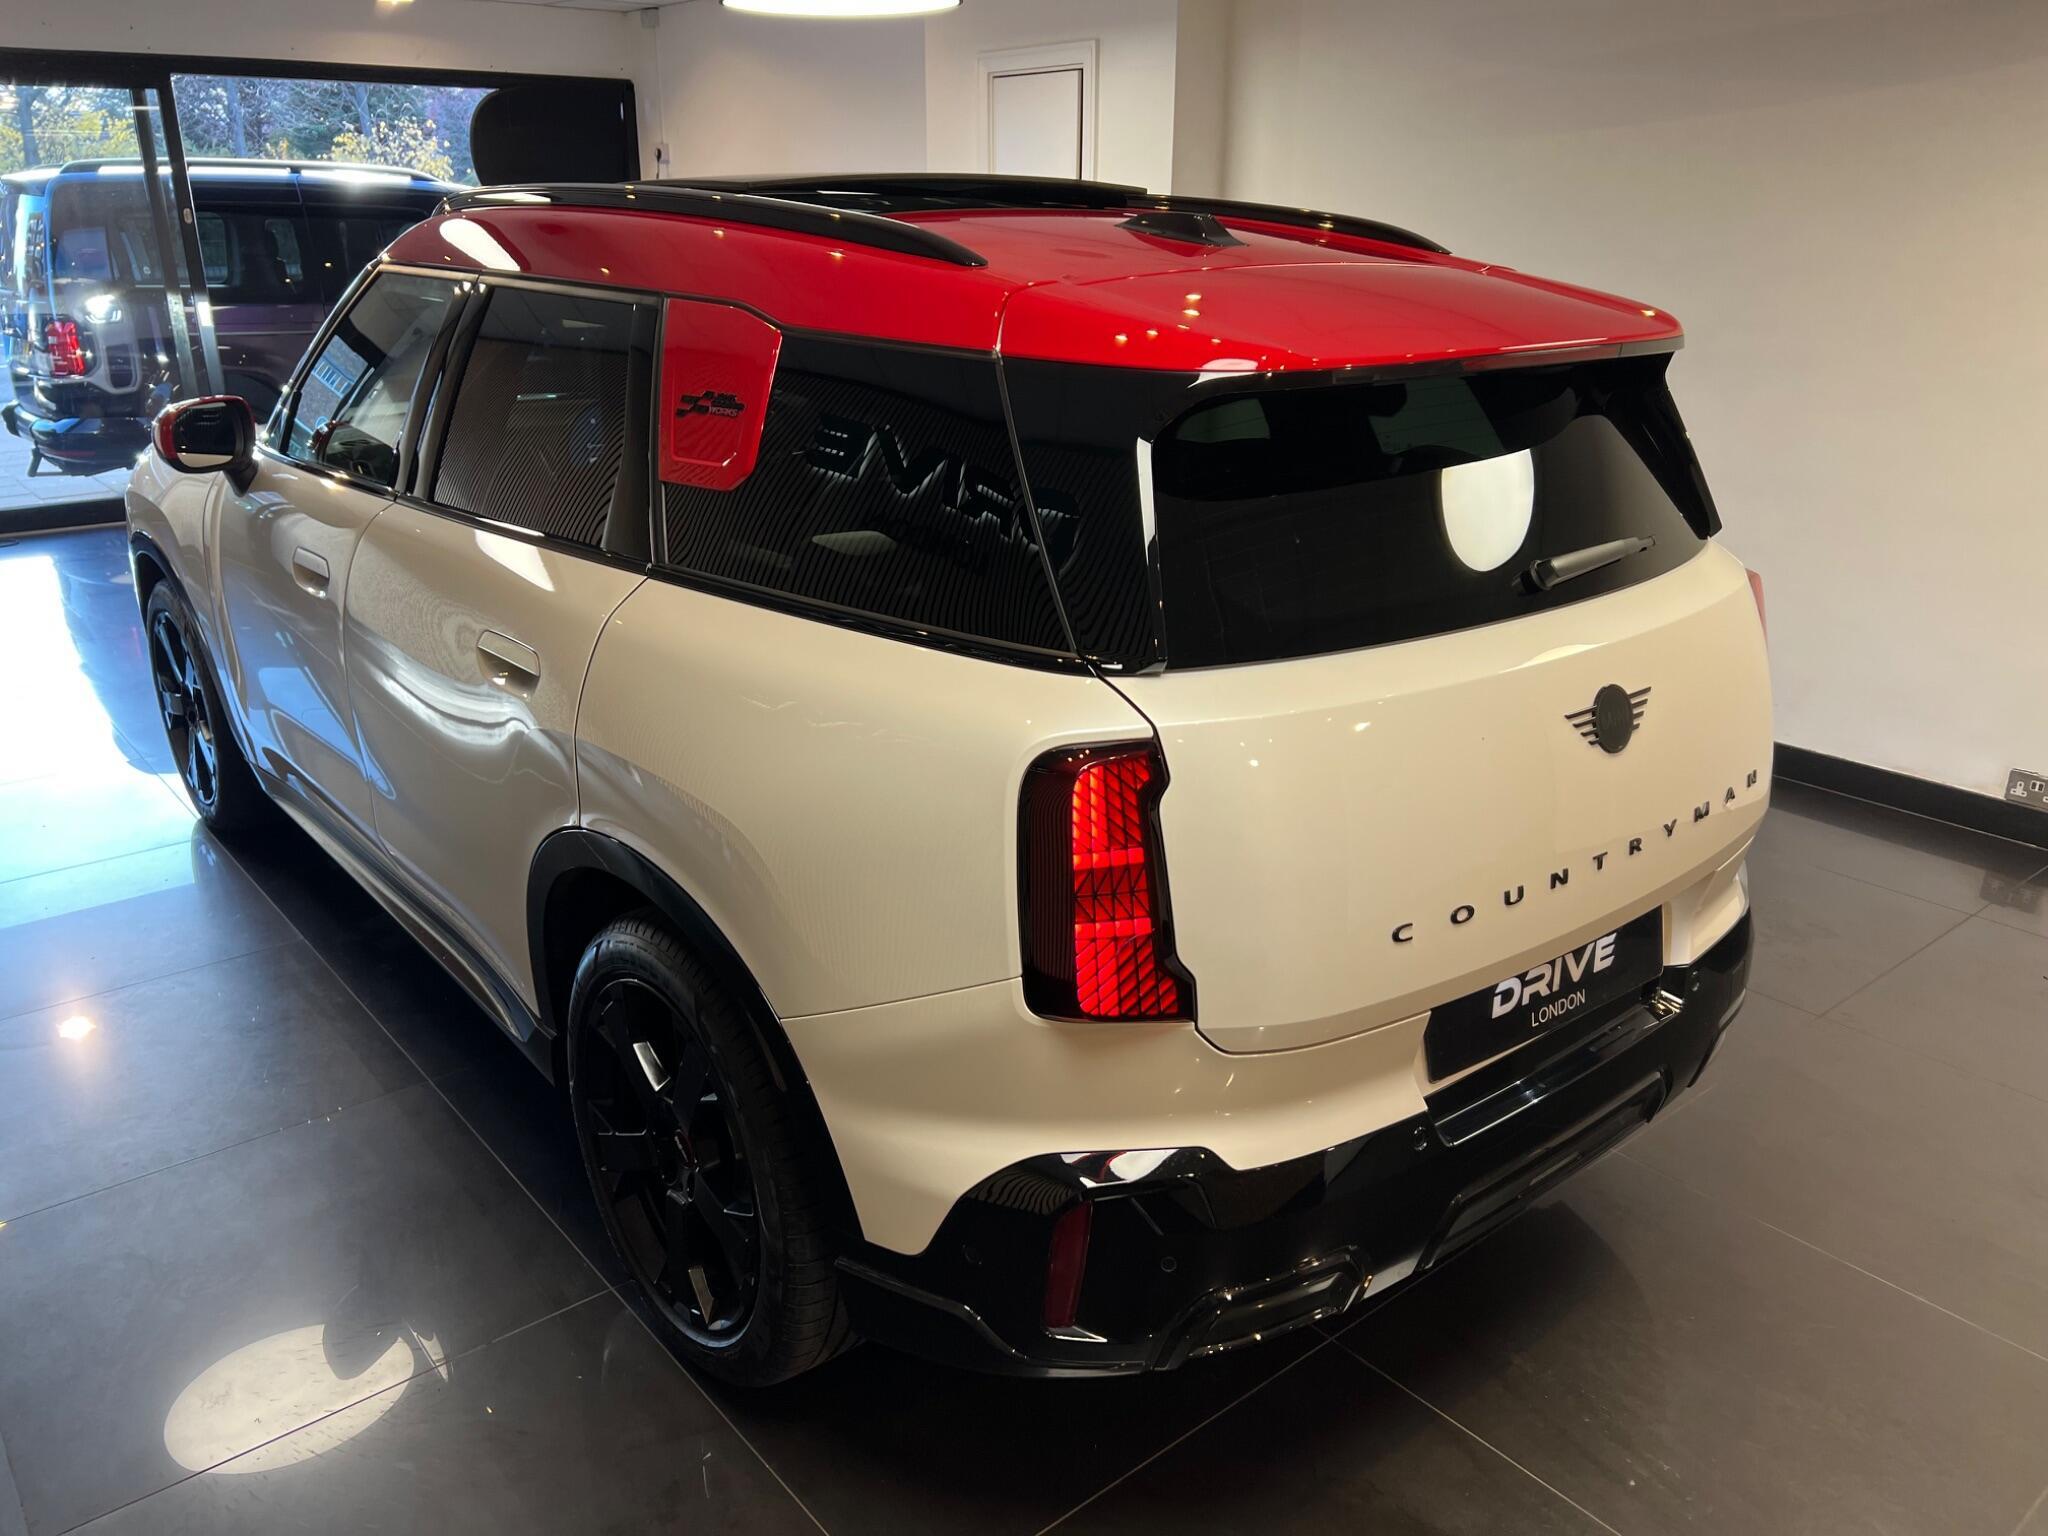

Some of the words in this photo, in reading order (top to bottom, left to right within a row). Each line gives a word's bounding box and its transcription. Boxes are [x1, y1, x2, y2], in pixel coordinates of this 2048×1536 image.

[1391, 769, 1757, 943] COUNTRYMAN
[1491, 932, 1617, 1019] DRIVE
[1531, 988, 1586, 1027] LONDON
